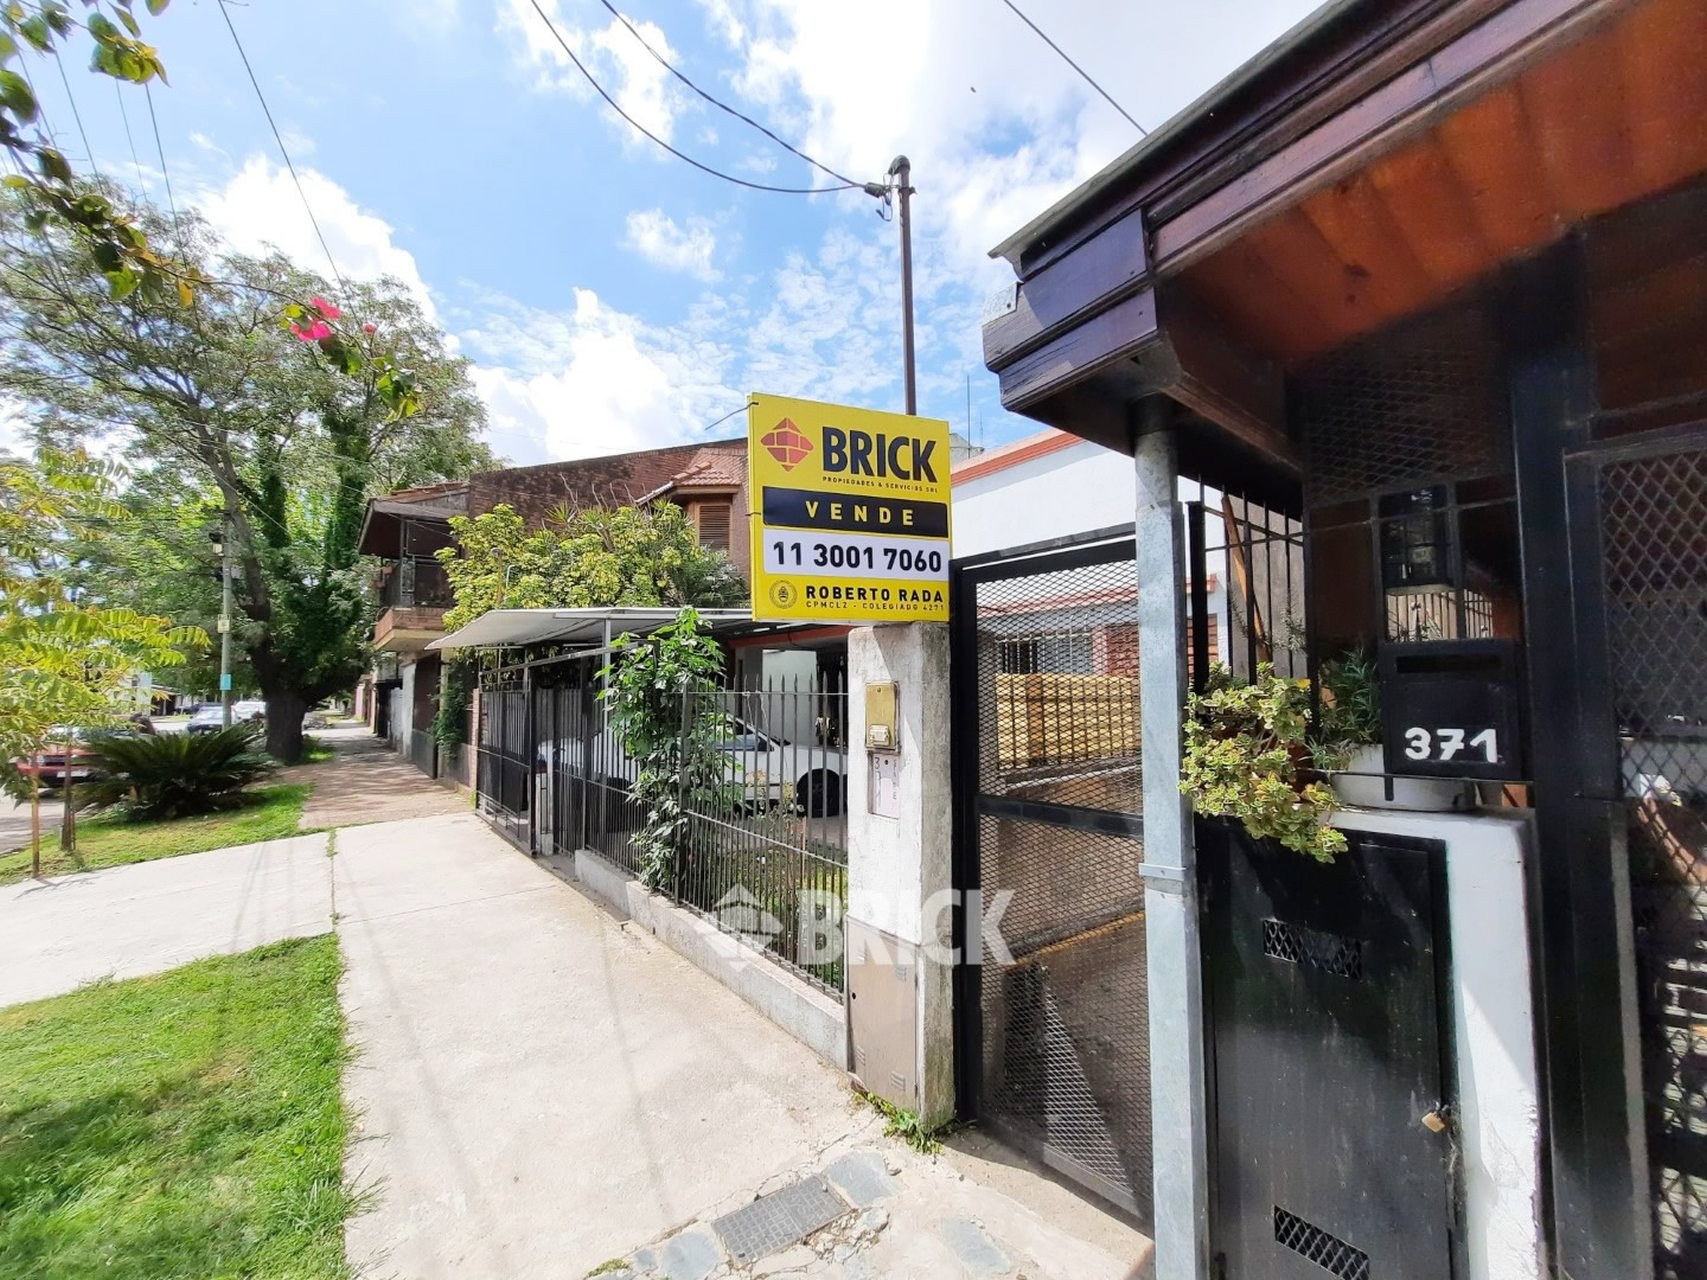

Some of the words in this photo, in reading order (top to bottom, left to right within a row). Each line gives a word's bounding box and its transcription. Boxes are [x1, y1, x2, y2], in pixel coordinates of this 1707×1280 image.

[822, 426, 937, 483] BRICK
[805, 501, 914, 526] VENDE
[773, 541, 802, 566] 11
[813, 543, 873, 569] 3001
[883, 548, 941, 572] 7060
[805, 586, 890, 601] ROBERTO
[899, 589, 943, 602] RADA
[862, 603, 918, 611] COLEGIADO
[1404, 726, 1498, 763] 371
